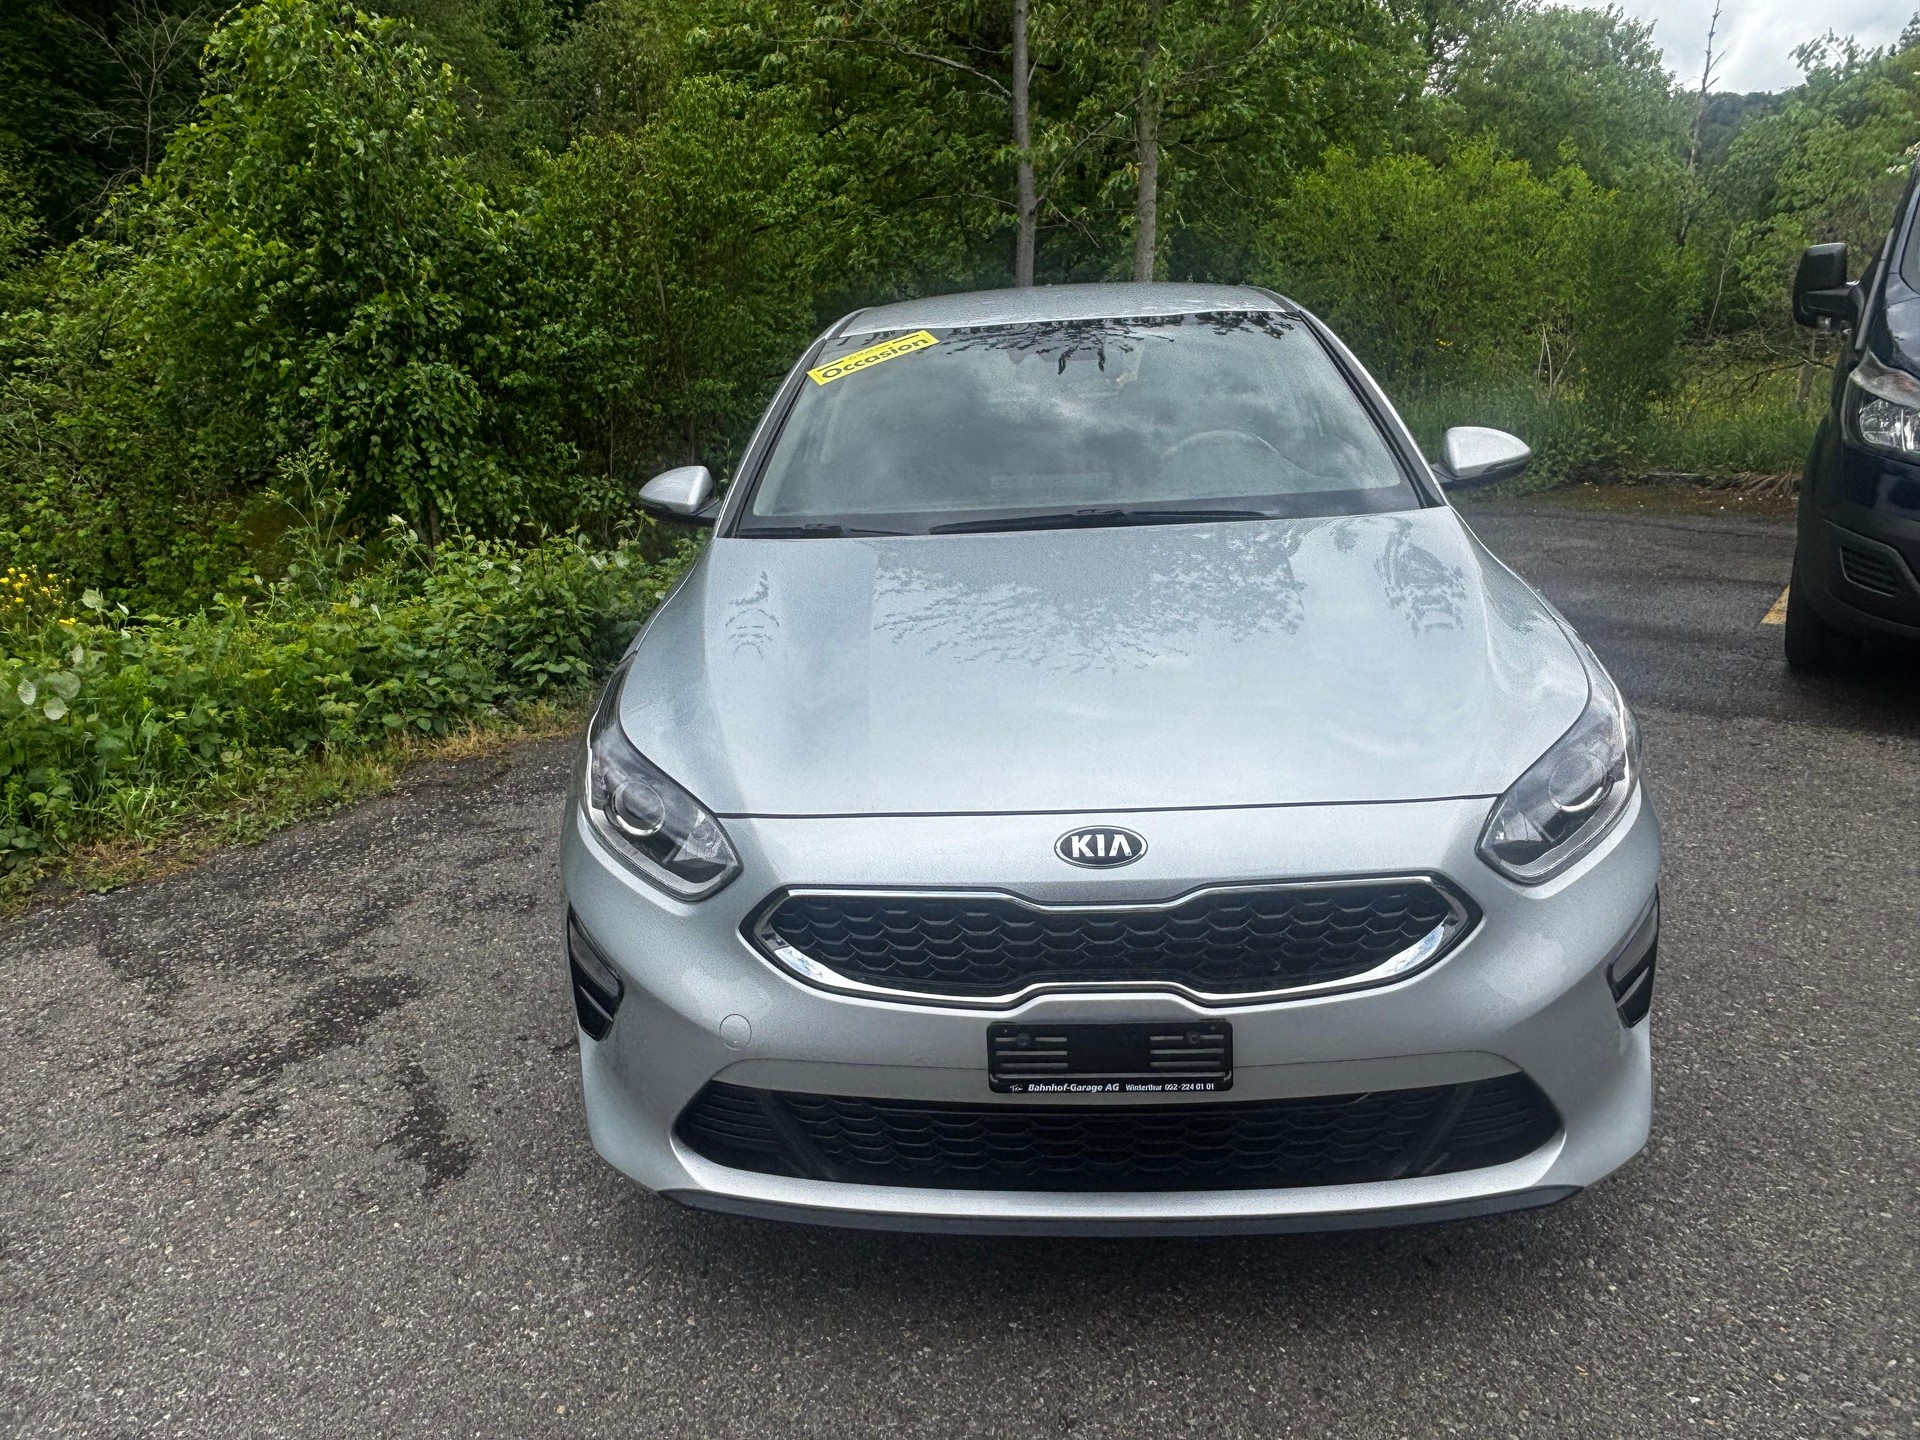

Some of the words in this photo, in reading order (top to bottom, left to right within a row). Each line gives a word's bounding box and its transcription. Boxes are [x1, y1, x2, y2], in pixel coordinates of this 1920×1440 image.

[821, 338, 930, 379] Occasion
[1070, 833, 1133, 858] KIA
[1027, 1083, 1104, 1093] Bahnhof-Garage
[1104, 1083, 1120, 1092] AG
